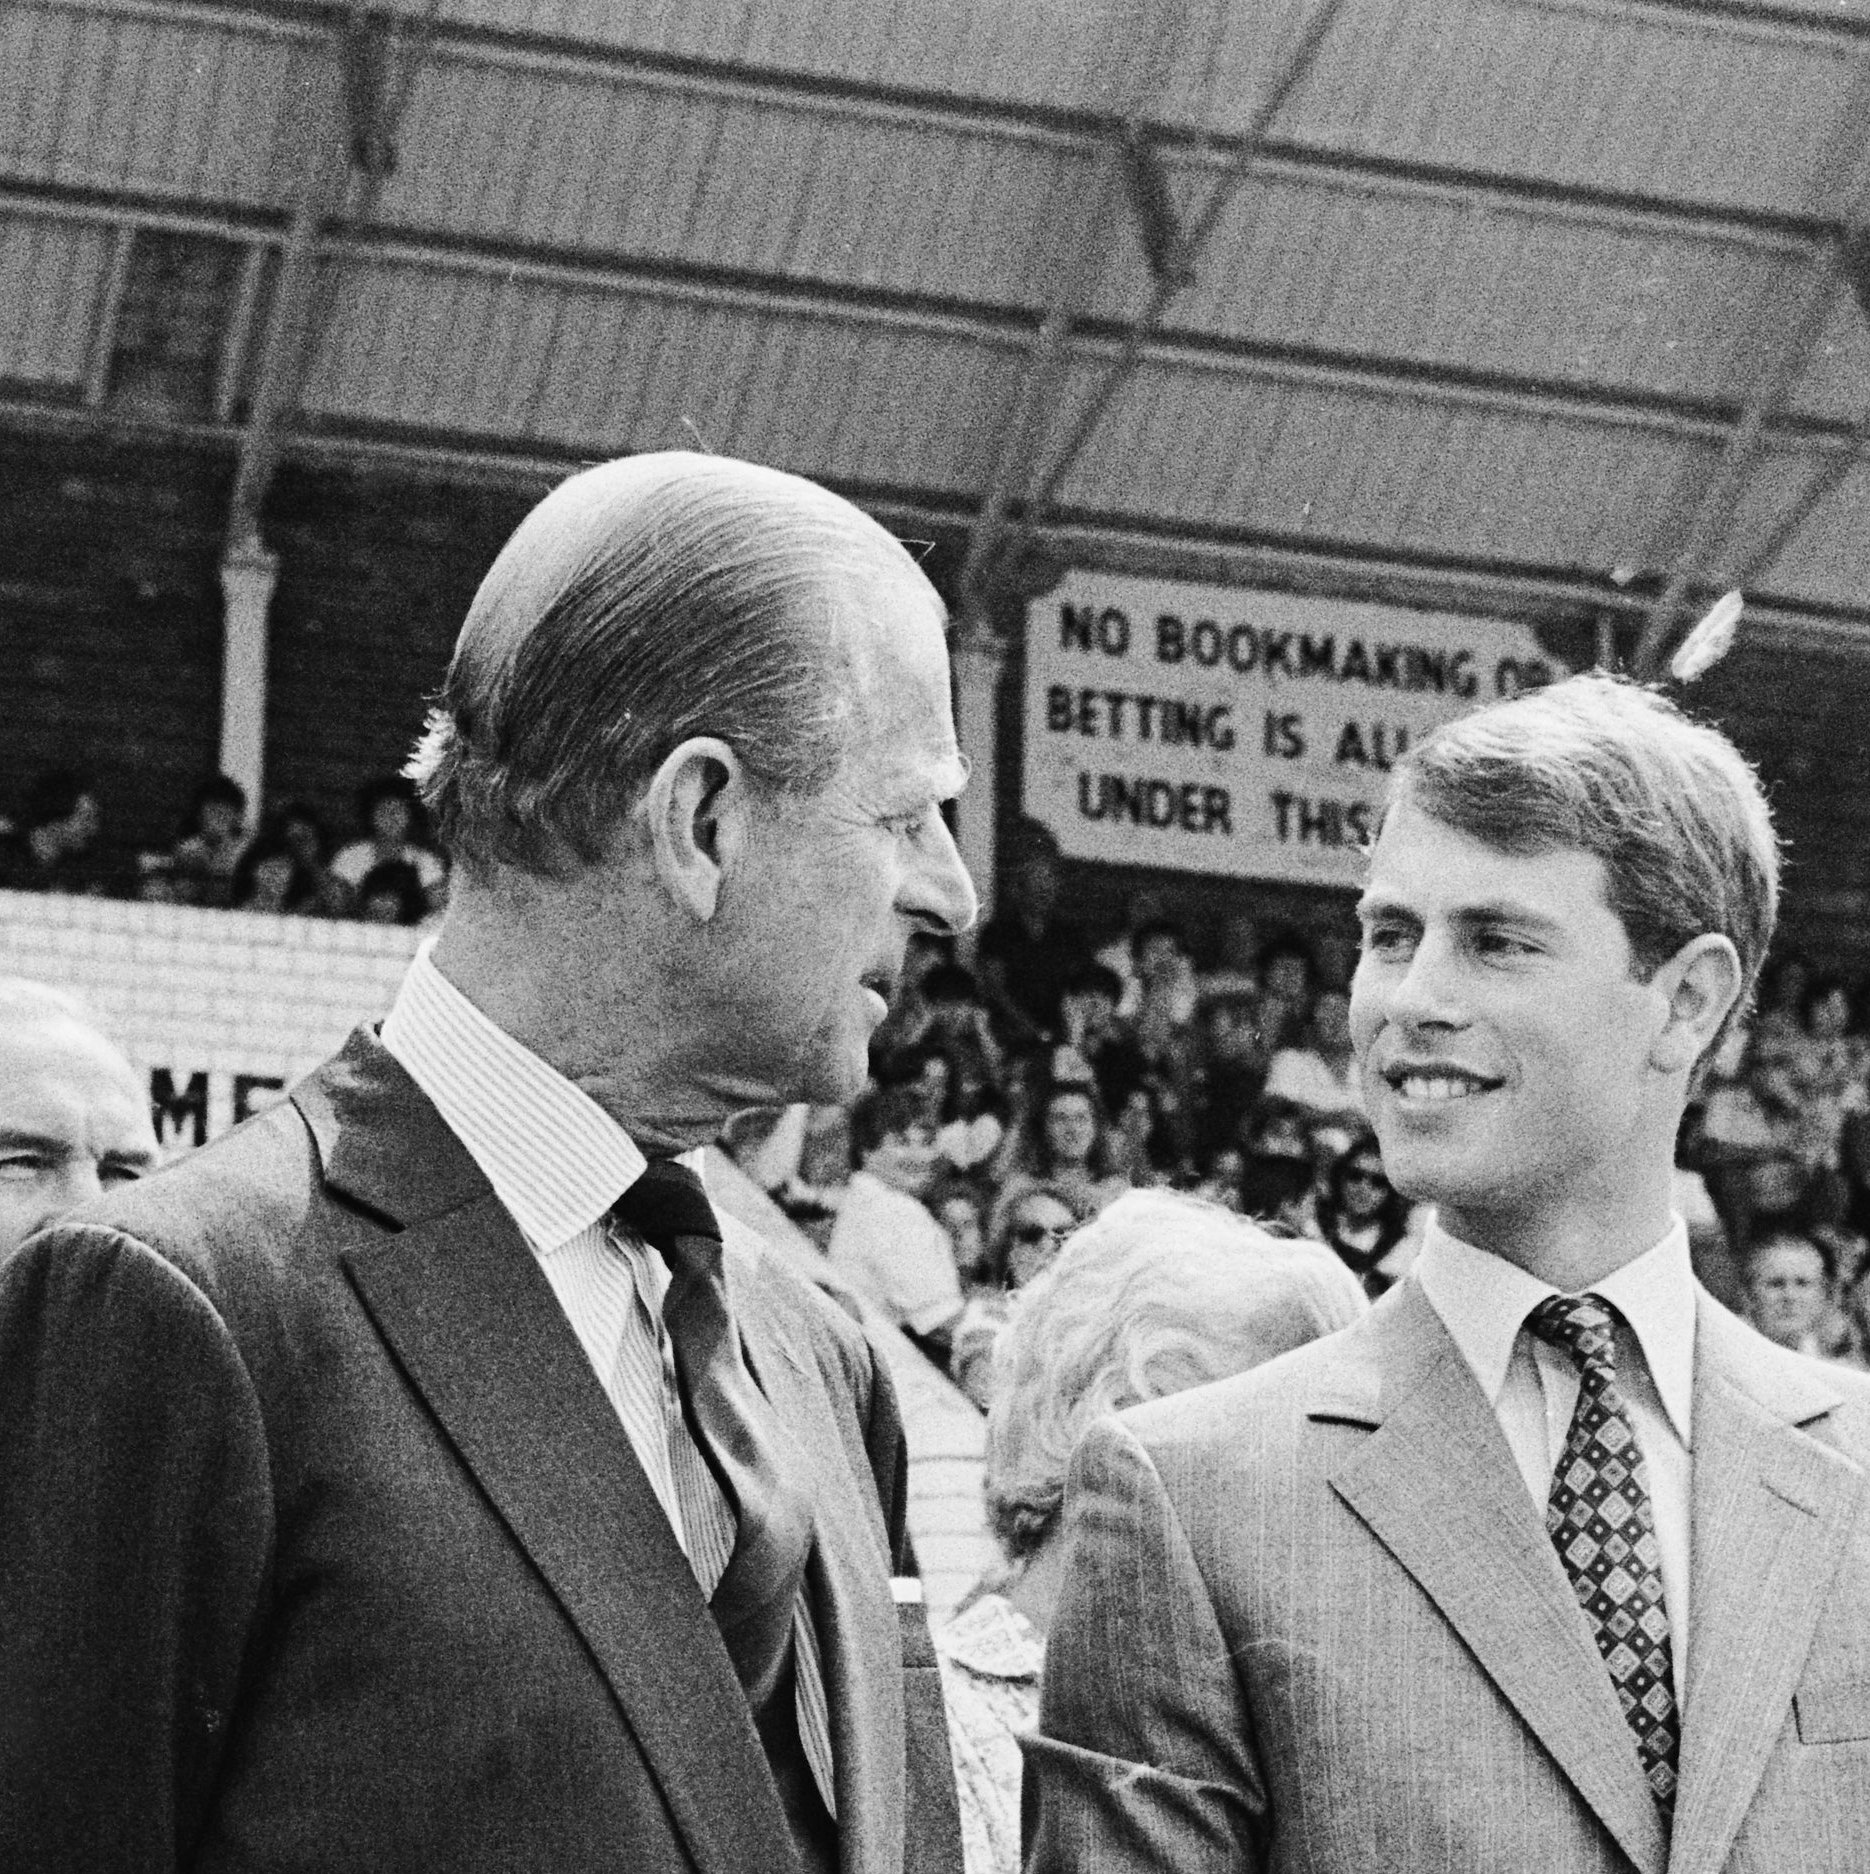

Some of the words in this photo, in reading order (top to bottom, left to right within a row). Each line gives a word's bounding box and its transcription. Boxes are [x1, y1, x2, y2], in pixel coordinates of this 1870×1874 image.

[1061, 604, 1128, 656] NO
[1156, 611, 1478, 698] BOOKMAKING
[1046, 685, 1234, 752] BETTING
[1264, 709, 1304, 760] IS
[1078, 773, 1232, 835] UNDER
[1273, 792, 1370, 846] THIS
